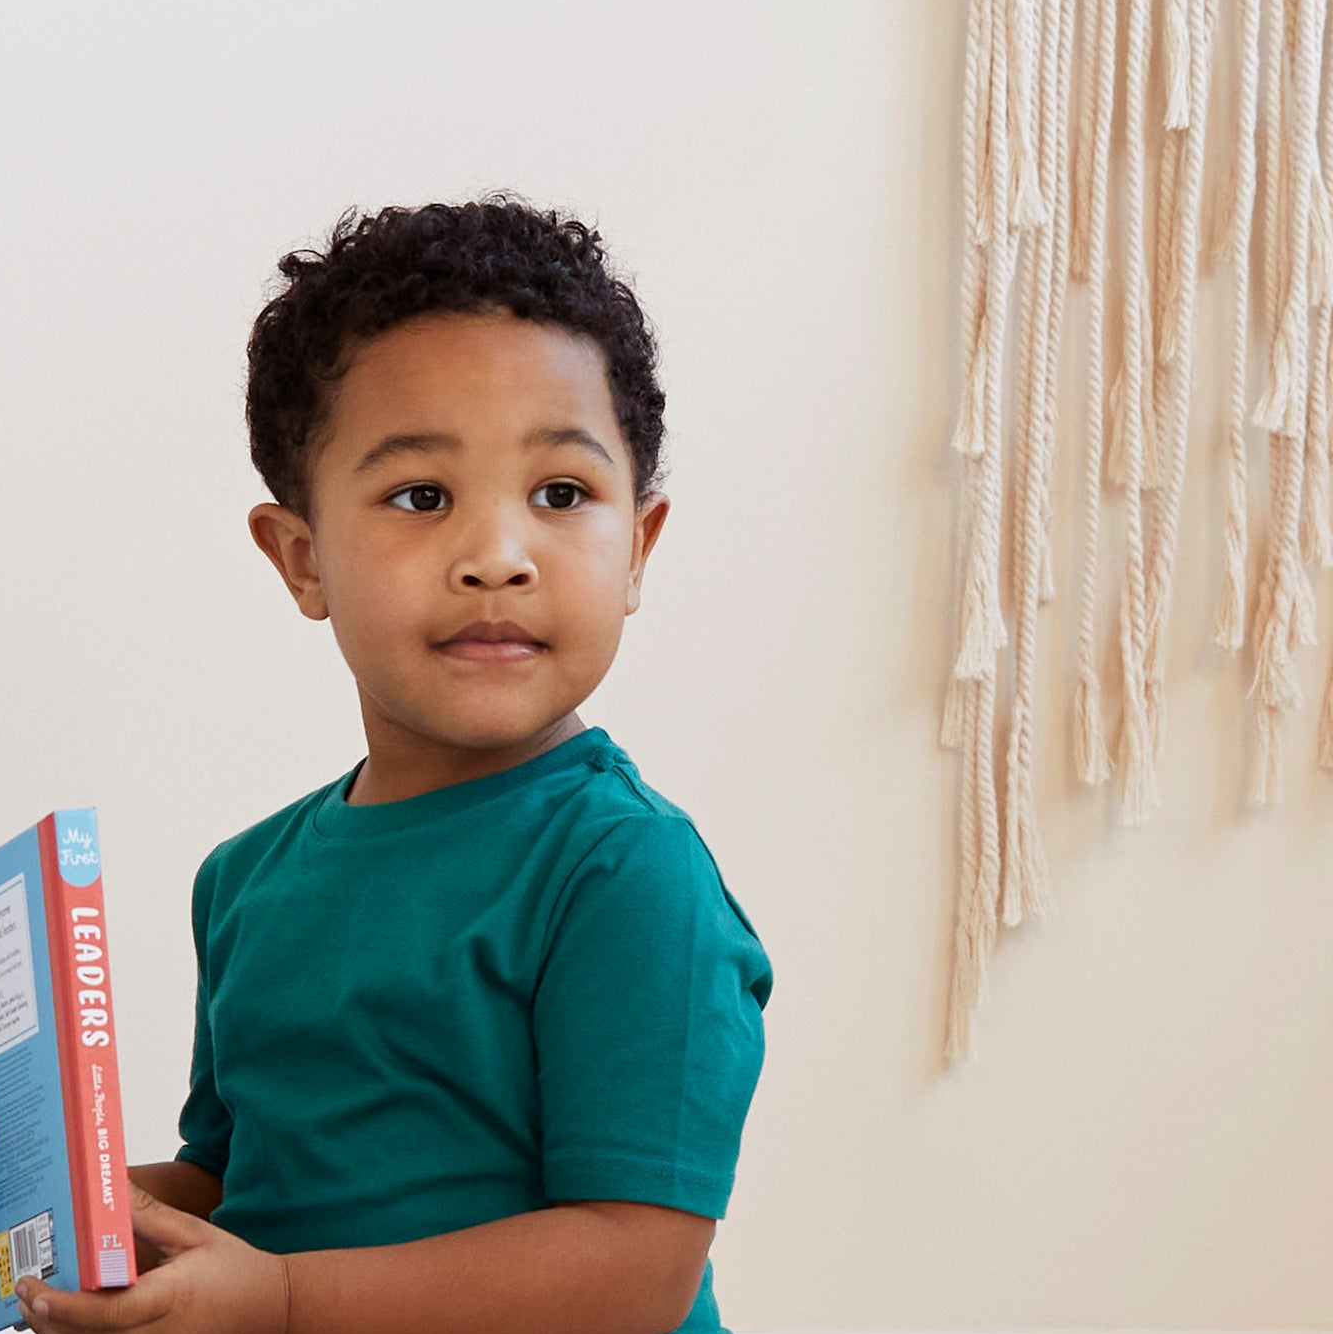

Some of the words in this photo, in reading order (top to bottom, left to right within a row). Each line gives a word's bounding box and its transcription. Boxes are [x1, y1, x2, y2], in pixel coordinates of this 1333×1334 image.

[62, 827, 93, 849] My
[59, 848, 98, 866] First
[71, 906, 110, 1048] LEADERS
[97, 1128, 109, 1151] BIG
[101, 1235, 122, 1249] FL
